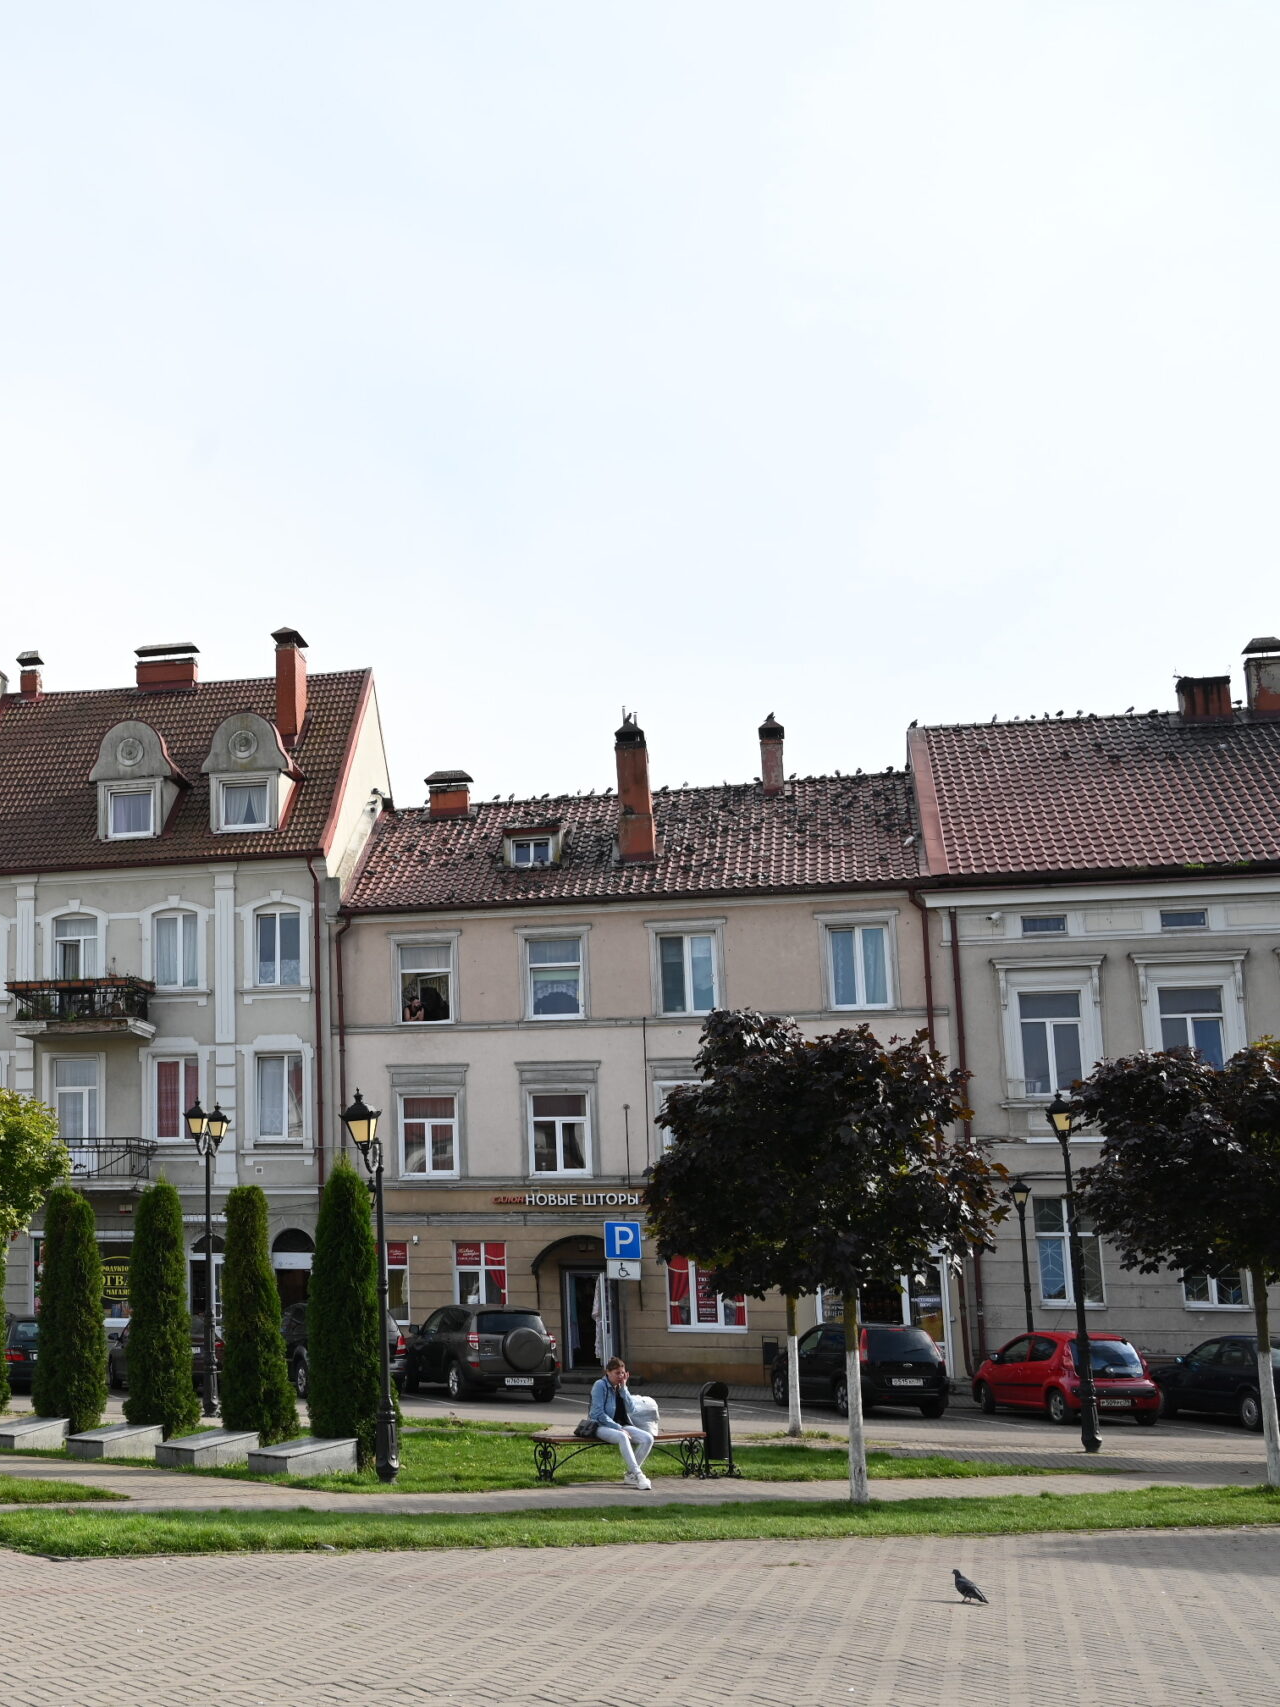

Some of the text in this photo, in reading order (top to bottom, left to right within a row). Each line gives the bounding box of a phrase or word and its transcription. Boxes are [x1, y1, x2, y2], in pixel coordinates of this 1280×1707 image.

[526, 1193, 578, 1206] НОВЫЕ
[582, 1193, 639, 1206] ШТОРЫ
[615, 1226, 634, 1255] P
